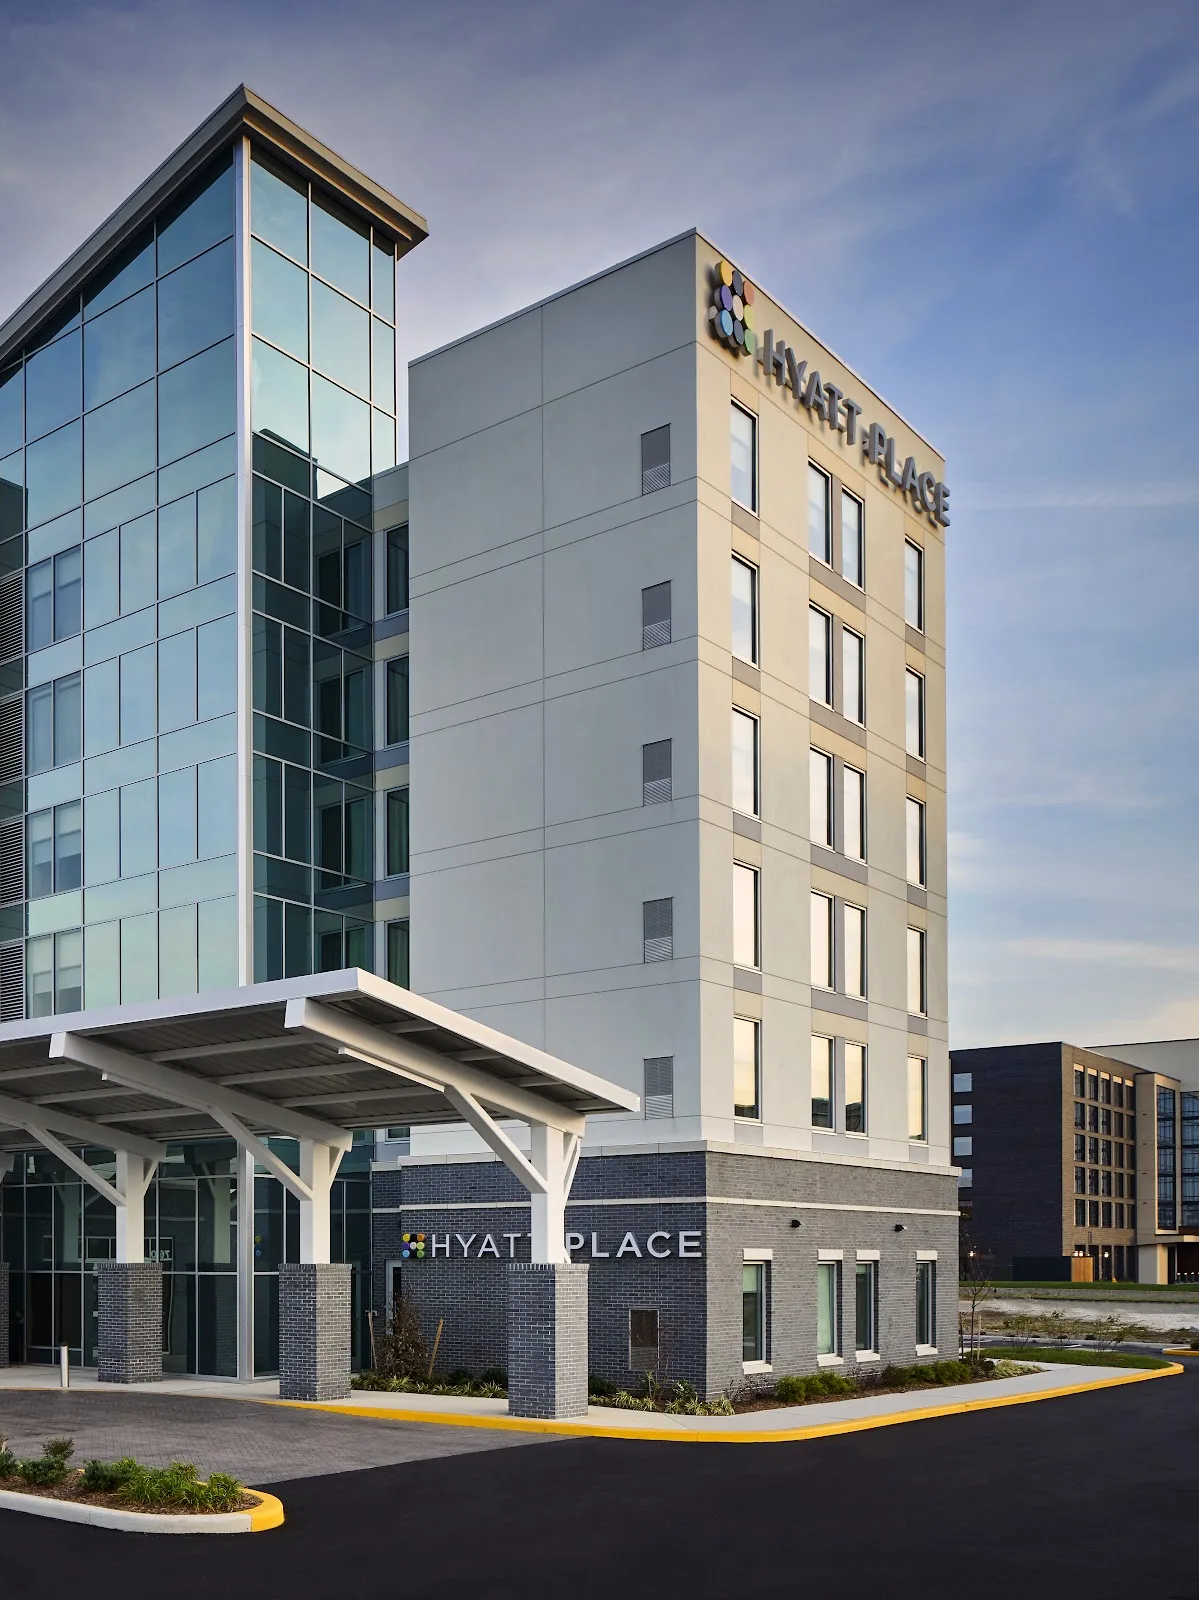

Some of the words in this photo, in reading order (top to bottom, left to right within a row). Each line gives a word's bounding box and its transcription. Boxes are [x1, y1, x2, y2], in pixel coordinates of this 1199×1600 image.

[762, 328, 862, 445] HYATT
[868, 422, 950, 527] PLACE
[431, 1233, 532, 1258] HYAT
[565, 1231, 702, 1258] PLACE
